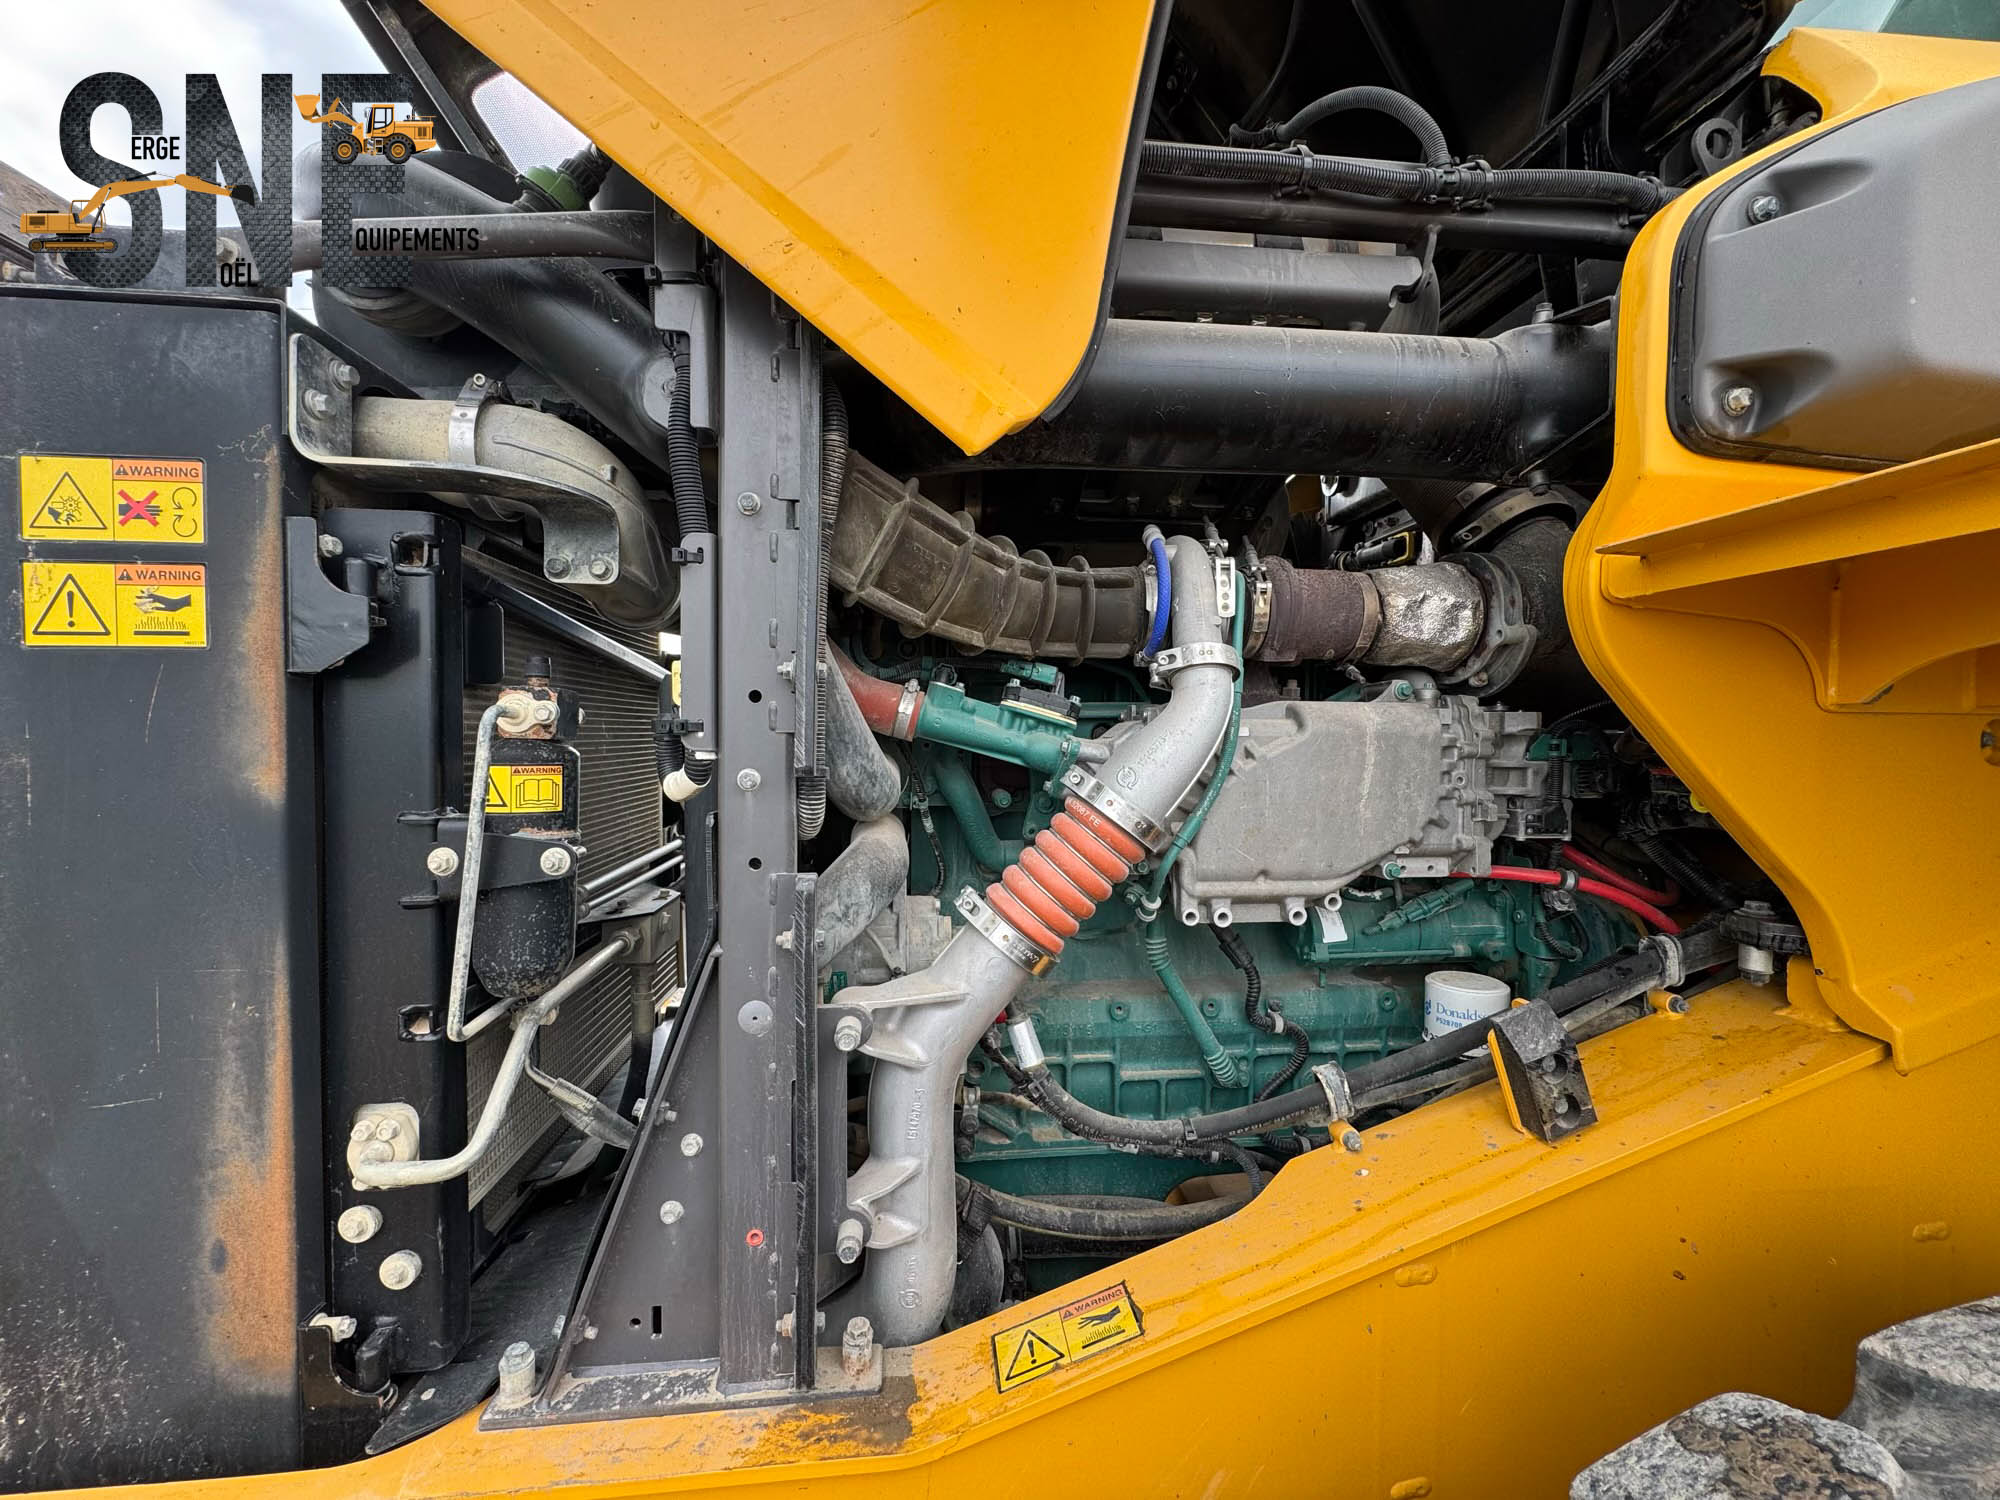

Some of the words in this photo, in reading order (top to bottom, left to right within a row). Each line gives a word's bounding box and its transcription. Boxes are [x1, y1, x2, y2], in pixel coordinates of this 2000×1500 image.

[130, 465, 199, 479] WARNING
[136, 569, 202, 582] WARNING
[1074, 1288, 1123, 1313] WARNING
